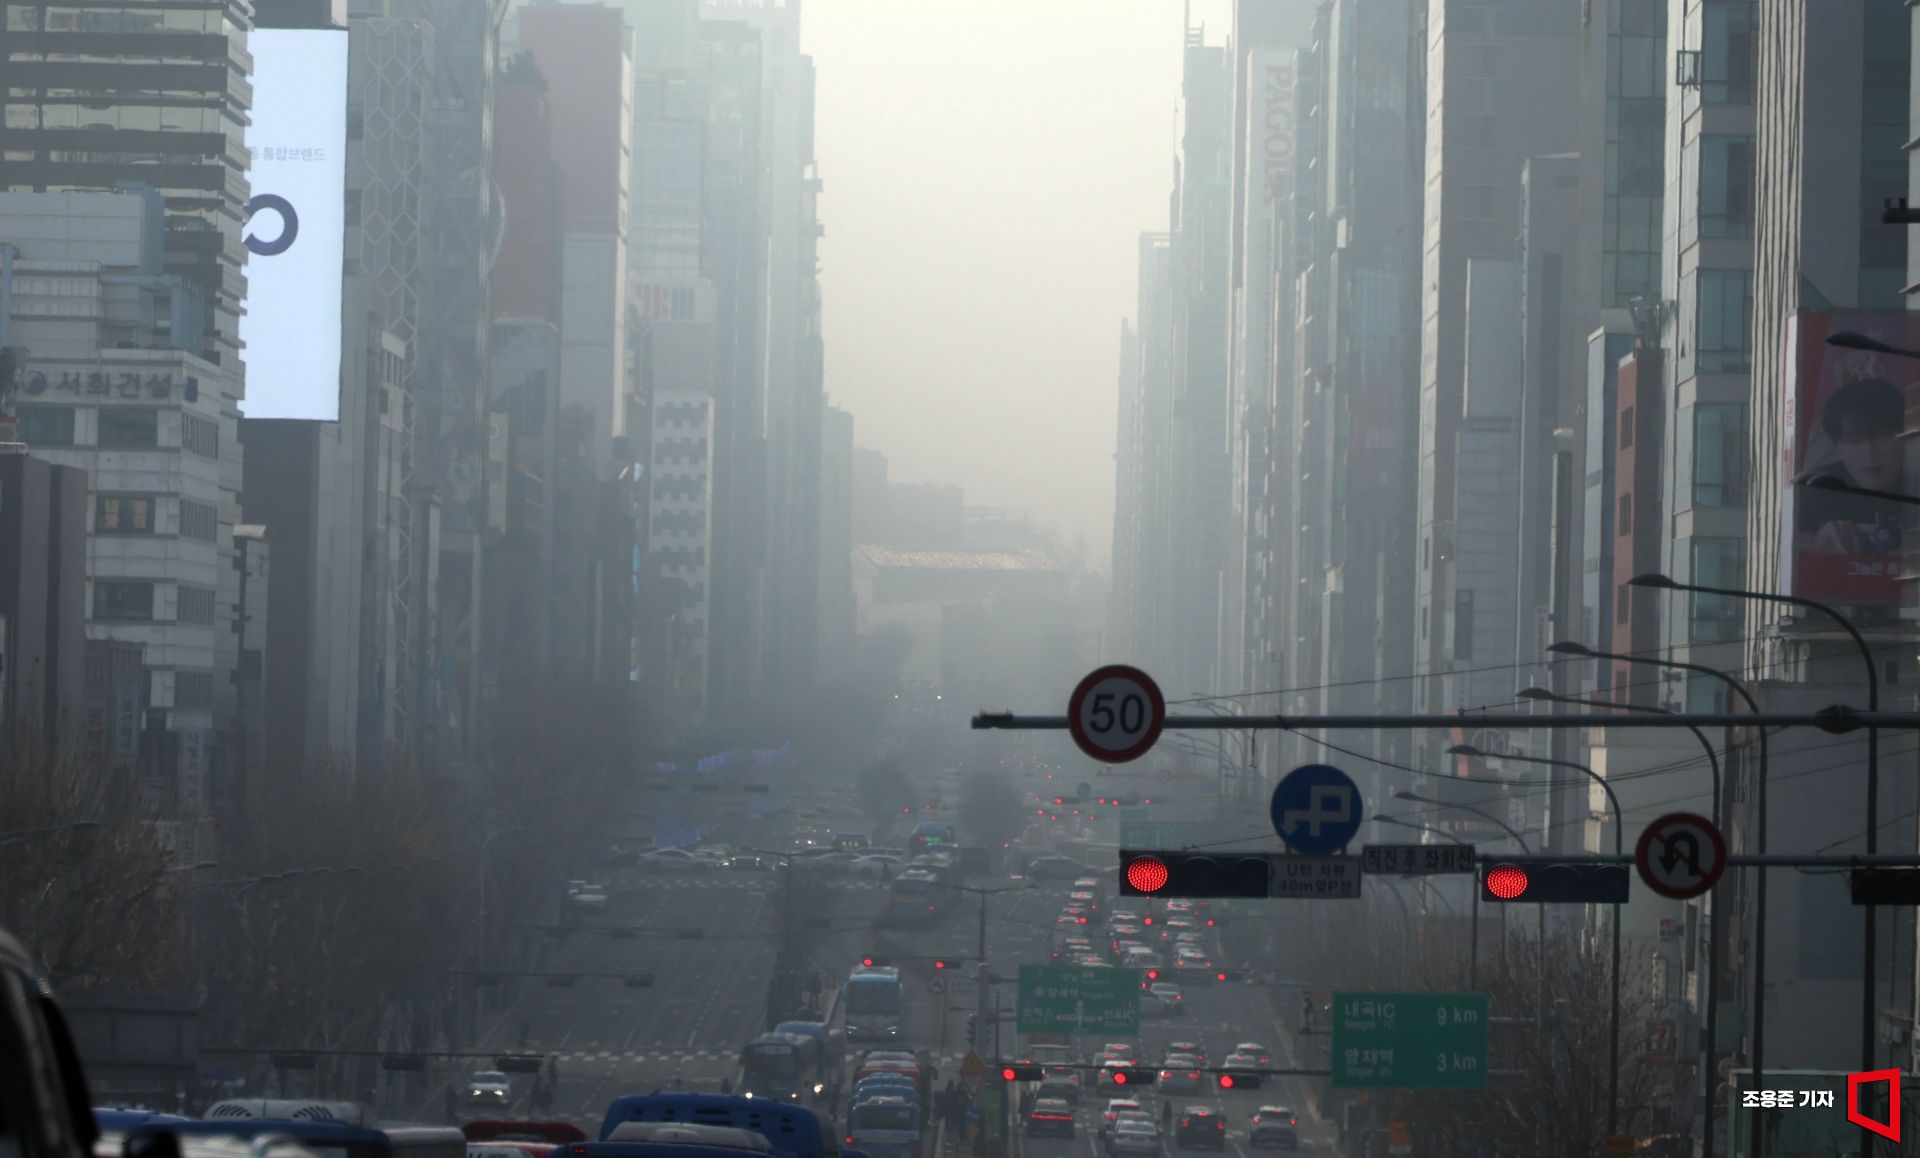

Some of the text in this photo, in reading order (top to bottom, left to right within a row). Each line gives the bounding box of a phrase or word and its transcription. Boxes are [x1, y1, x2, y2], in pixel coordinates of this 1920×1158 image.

[263, 146, 326, 161] 통합브랜드
[57, 372, 171, 399] 서희건설
[1089, 693, 1144, 734] 50
[1287, 863, 1345, 878] U턴 차량
[1367, 848, 1471, 871] 직진 후 좌회전
[1344, 1000, 1478, 1025] 내곡IC 9 km
[1344, 1047, 1478, 1072] 양재역 3 km
